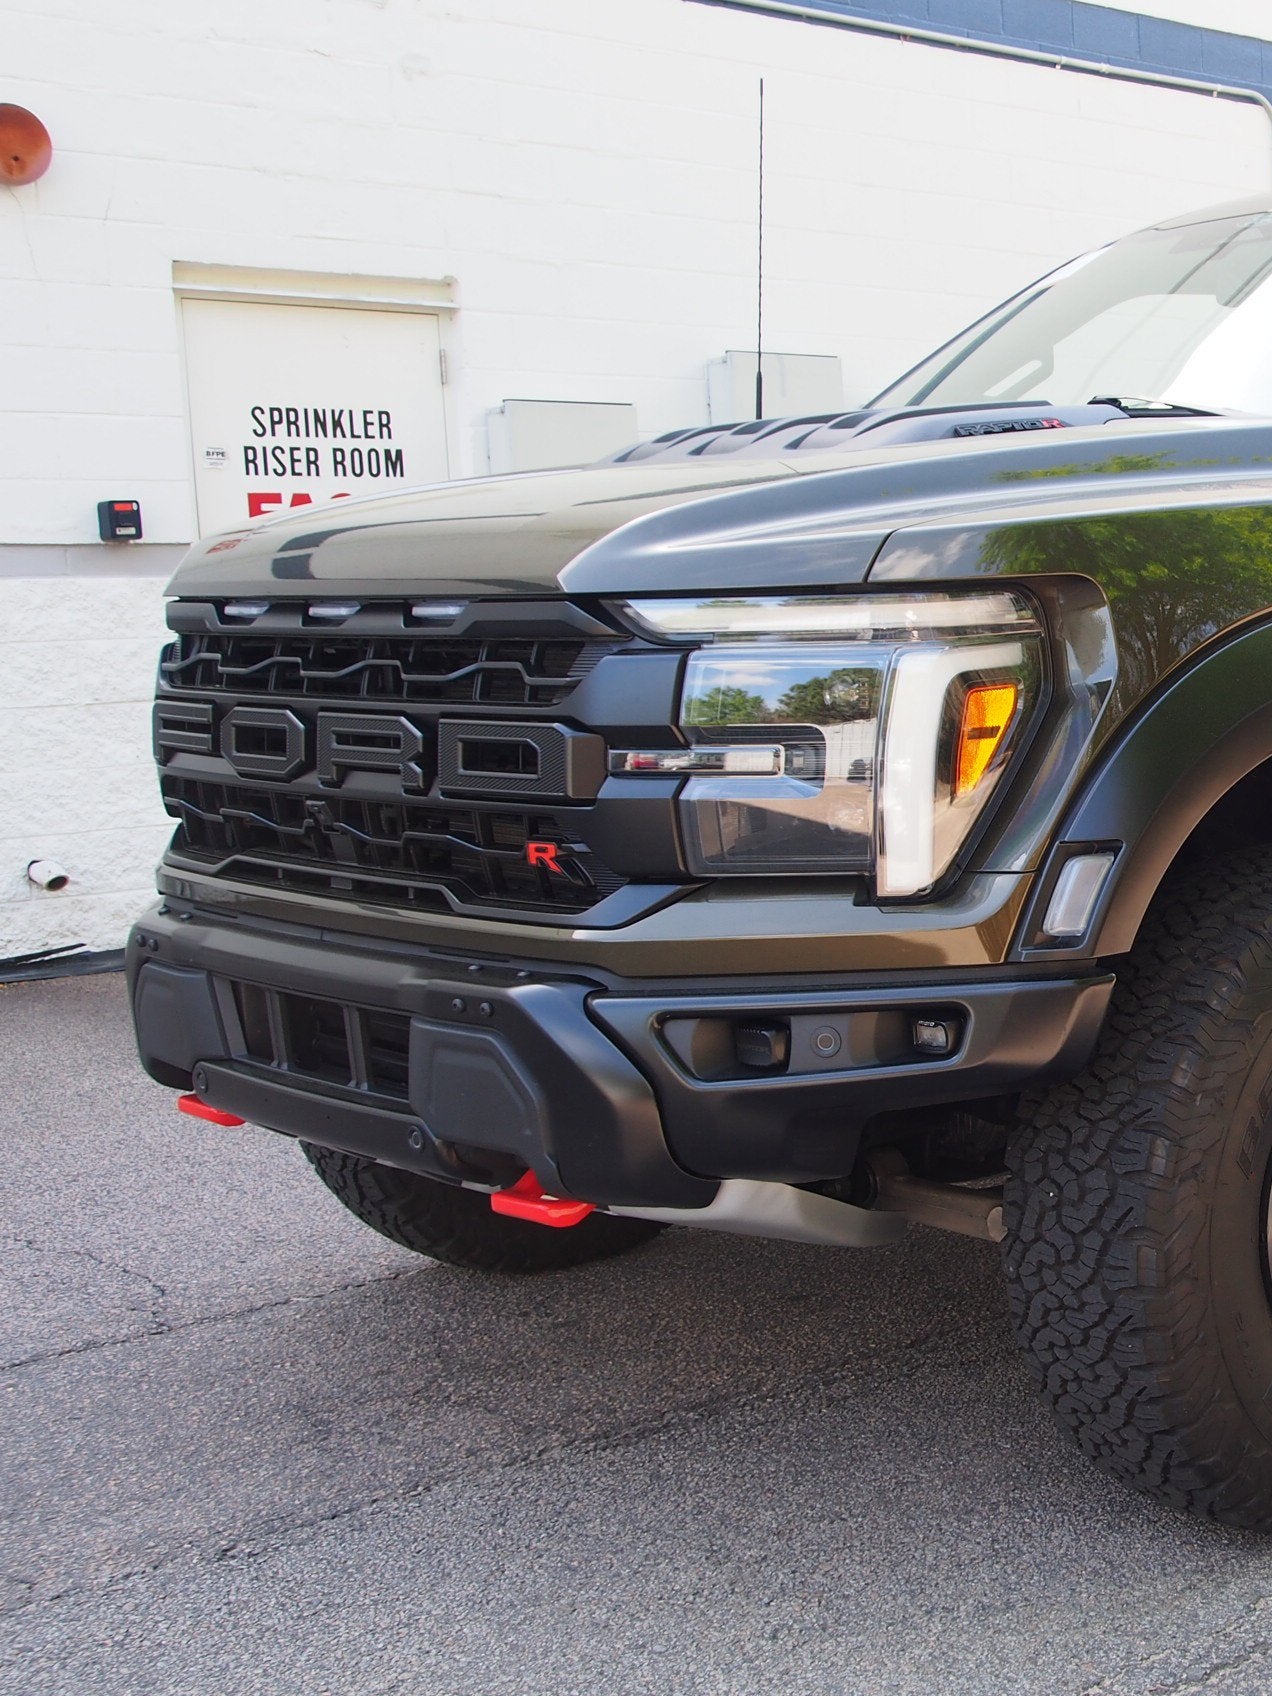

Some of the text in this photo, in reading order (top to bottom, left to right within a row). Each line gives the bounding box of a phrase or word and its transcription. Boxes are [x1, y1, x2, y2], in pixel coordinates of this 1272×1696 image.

[251, 405, 393, 439] SPRINKLER
[956, 418, 1064, 437] RAPTOR
[243, 445, 404, 478] RISER ROOM
[154, 700, 602, 799] FORD
[526, 840, 564, 876] R
